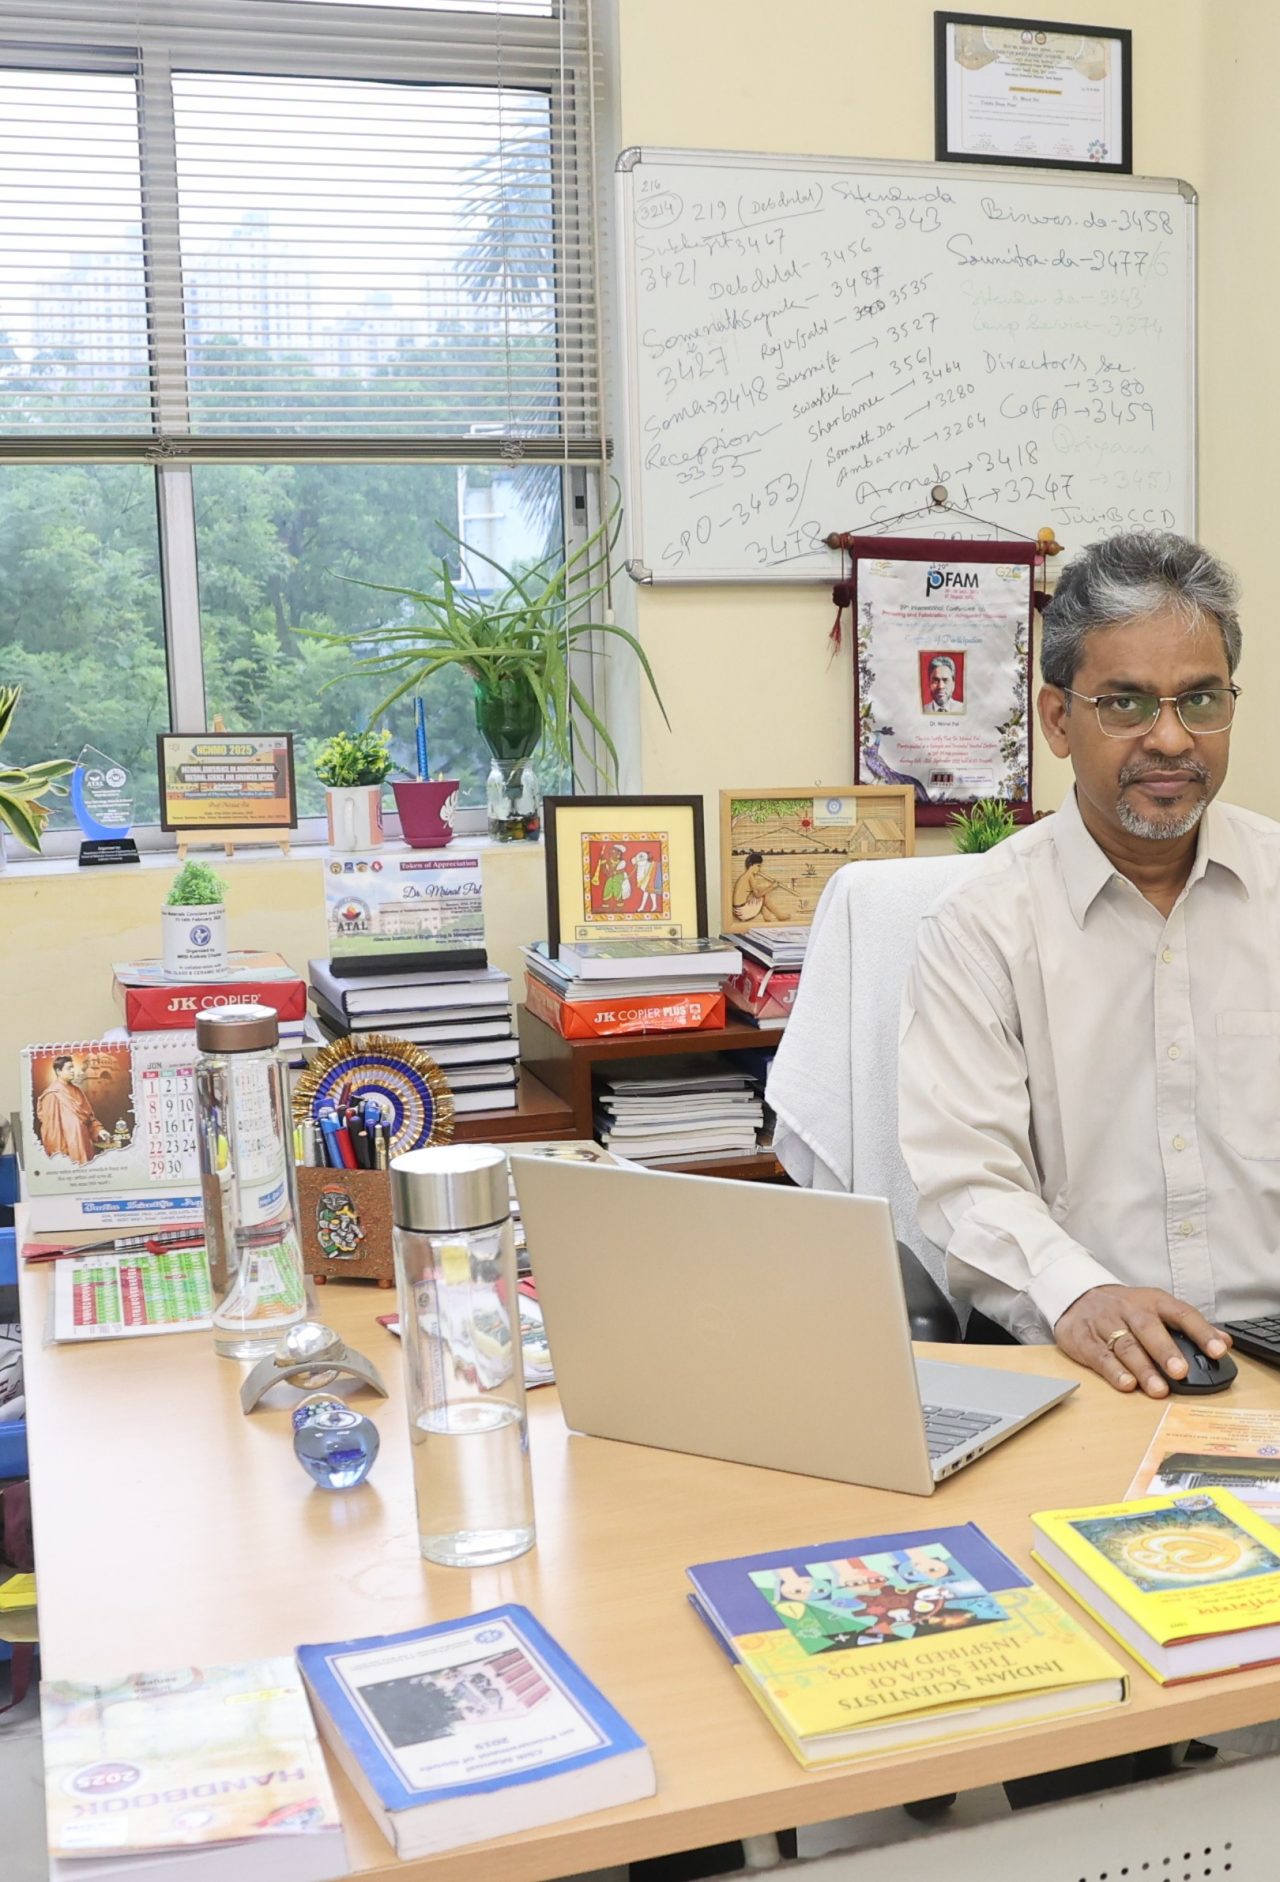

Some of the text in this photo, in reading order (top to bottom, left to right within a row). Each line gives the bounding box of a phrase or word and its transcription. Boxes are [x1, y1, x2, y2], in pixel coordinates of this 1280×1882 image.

[640, 203, 676, 220] 3214
[692, 201, 726, 221] 219
[865, 206, 941, 232] 3343
[821, 237, 872, 268] 3456
[639, 259, 697, 291] 3421
[887, 312, 940, 343] 3527
[889, 346, 933, 376] 3561
[1092, 398, 1155, 431] 3459
[977, 441, 1038, 472] 3418
[1004, 474, 1074, 503] 3247
[432, 859, 478, 869] Appreciation
[337, 920, 369, 932] ATAL
[167, 993, 259, 1012] JK COPIER
[594, 1005, 686, 1023] JK COPIER PLUS
[166, 1080, 171, 1092] 2
[183, 1078, 188, 1091] 3
[149, 1098, 194, 1114] 8 9 10
[148, 1119, 194, 1134] 15 16 17
[150, 1139, 196, 1154] 22 23 24
[152, 1160, 181, 1174] 29 30
[827, 1637, 1022, 1680] INSPIRED MINDS
[867, 1654, 1018, 1690] THE SAGA OF
[839, 1660, 1064, 1711] INDIAN SCIENTISTS
[75, 1769, 137, 1790] 2025
[72, 1767, 307, 1820] HANDBOOK
